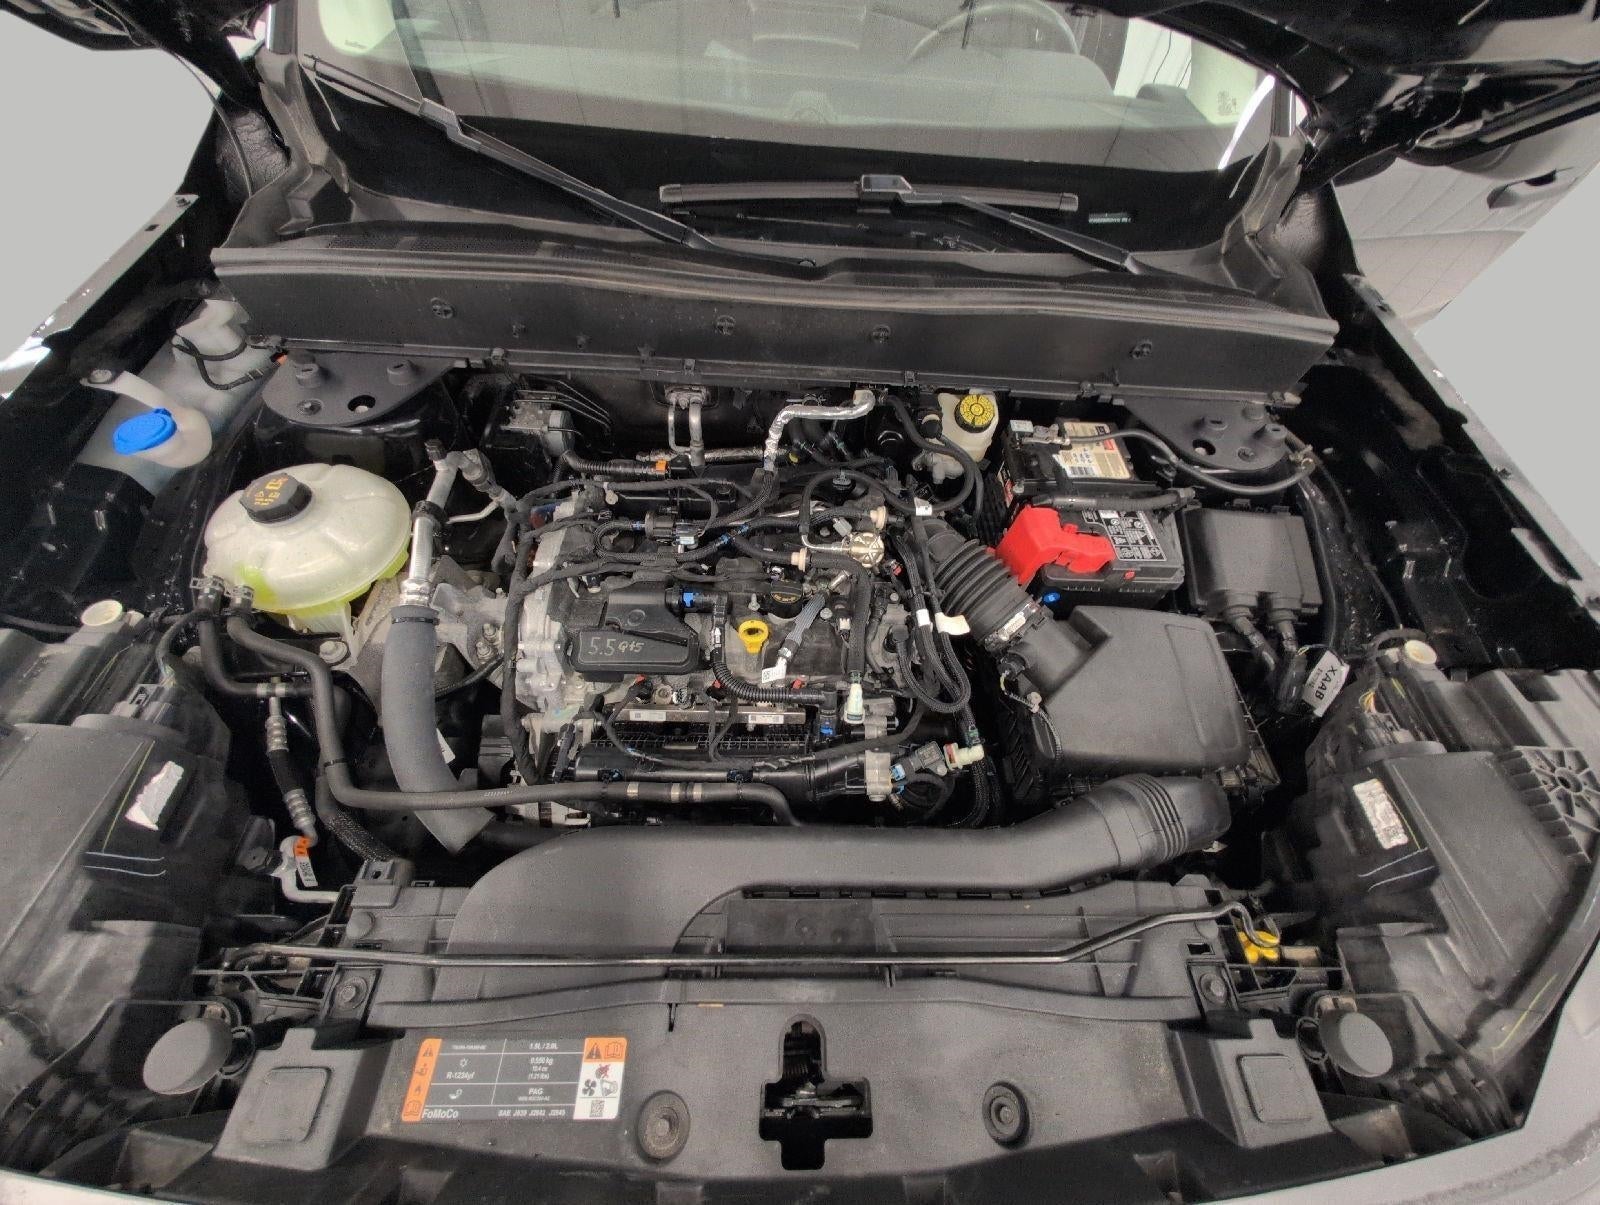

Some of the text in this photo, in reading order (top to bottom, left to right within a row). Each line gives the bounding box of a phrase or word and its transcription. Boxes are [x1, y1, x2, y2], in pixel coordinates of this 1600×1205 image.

[588, 636, 616, 656] 5.5
[1314, 665, 1338, 700] XAAB
[528, 1087, 544, 1096] PAG
[421, 1109, 459, 1119] FoMoCo
